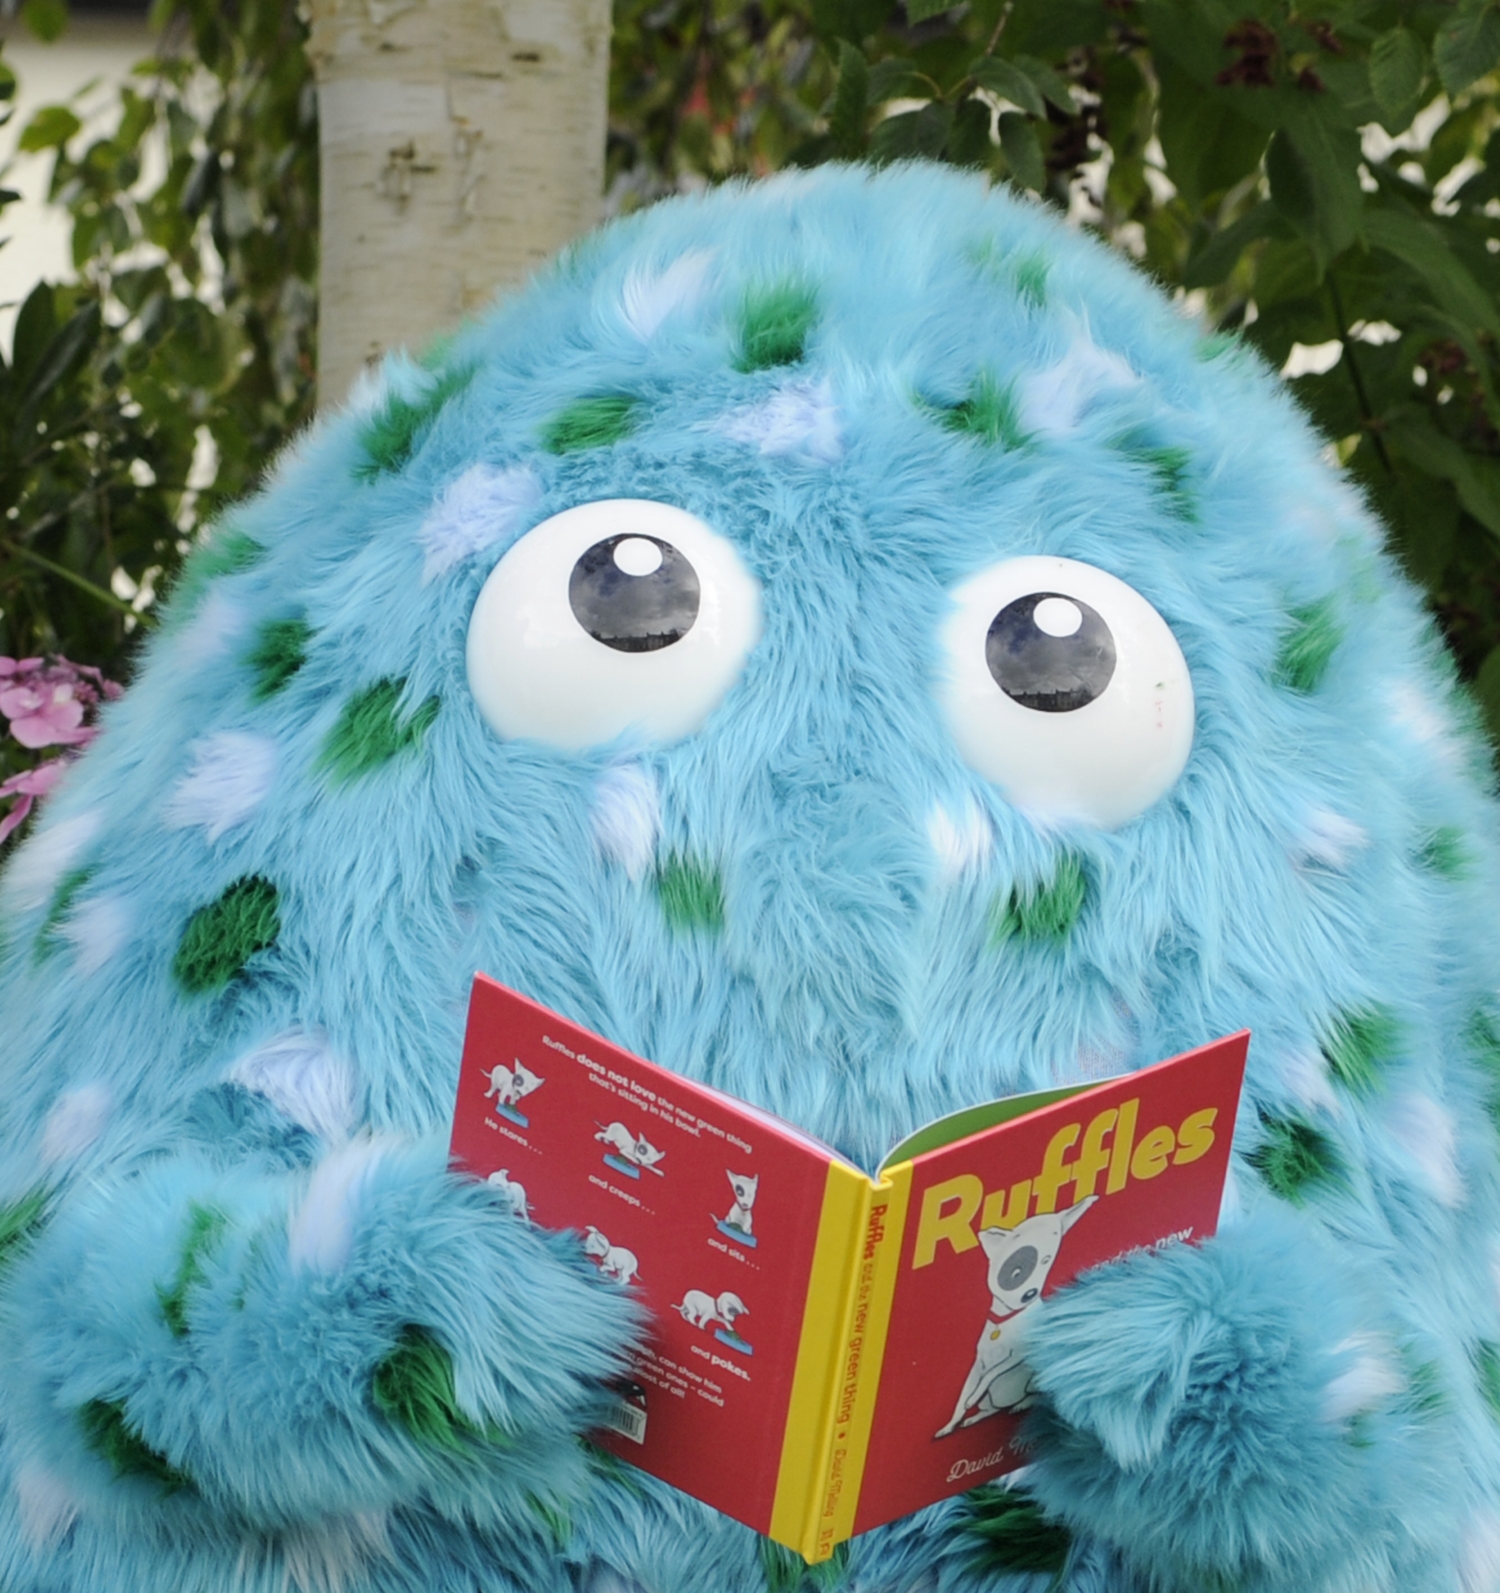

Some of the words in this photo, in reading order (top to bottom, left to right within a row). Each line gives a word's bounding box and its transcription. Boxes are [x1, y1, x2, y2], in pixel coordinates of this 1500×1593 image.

[542, 1035, 575, 1060] Ruffles
[577, 1053, 606, 1075] does
[607, 1070, 629, 1088] not
[630, 1080, 656, 1101] love
[658, 1096, 675, 1112] the
[675, 1106, 696, 1123] new
[696, 1118, 725, 1139] green
[726, 1133, 752, 1154] thing
[588, 1072, 616, 1093] that's
[617, 1088, 648, 1112] sitting
[649, 1103, 659, 1115] in
[660, 1110, 674, 1124] his
[675, 1118, 701, 1138] bowl.
[484, 1117, 498, 1130] He
[499, 1126, 529, 1147] stares
[588, 1174, 607, 1190] and
[608, 1186, 641, 1208] creeps
[912, 1097, 1218, 1270] Ruffles
[707, 1238, 728, 1253] and
[864, 1203, 888, 1260] Ruffles
[1155, 1226, 1193, 1250] new
[855, 1303, 868, 1333] new
[658, 1355, 677, 1370] can
[678, 1366, 703, 1383] show
[703, 1377, 722, 1394] him
[690, 1345, 711, 1360] and
[711, 1355, 751, 1381] pokes.
[849, 1338, 862, 1381] green
[658, 1379, 671, 1390] of
[665, 1371, 689, 1389] ones
[697, 1388, 725, 1408] could
[837, 1383, 857, 1424] thing
[946, 1446, 1004, 1482] David
